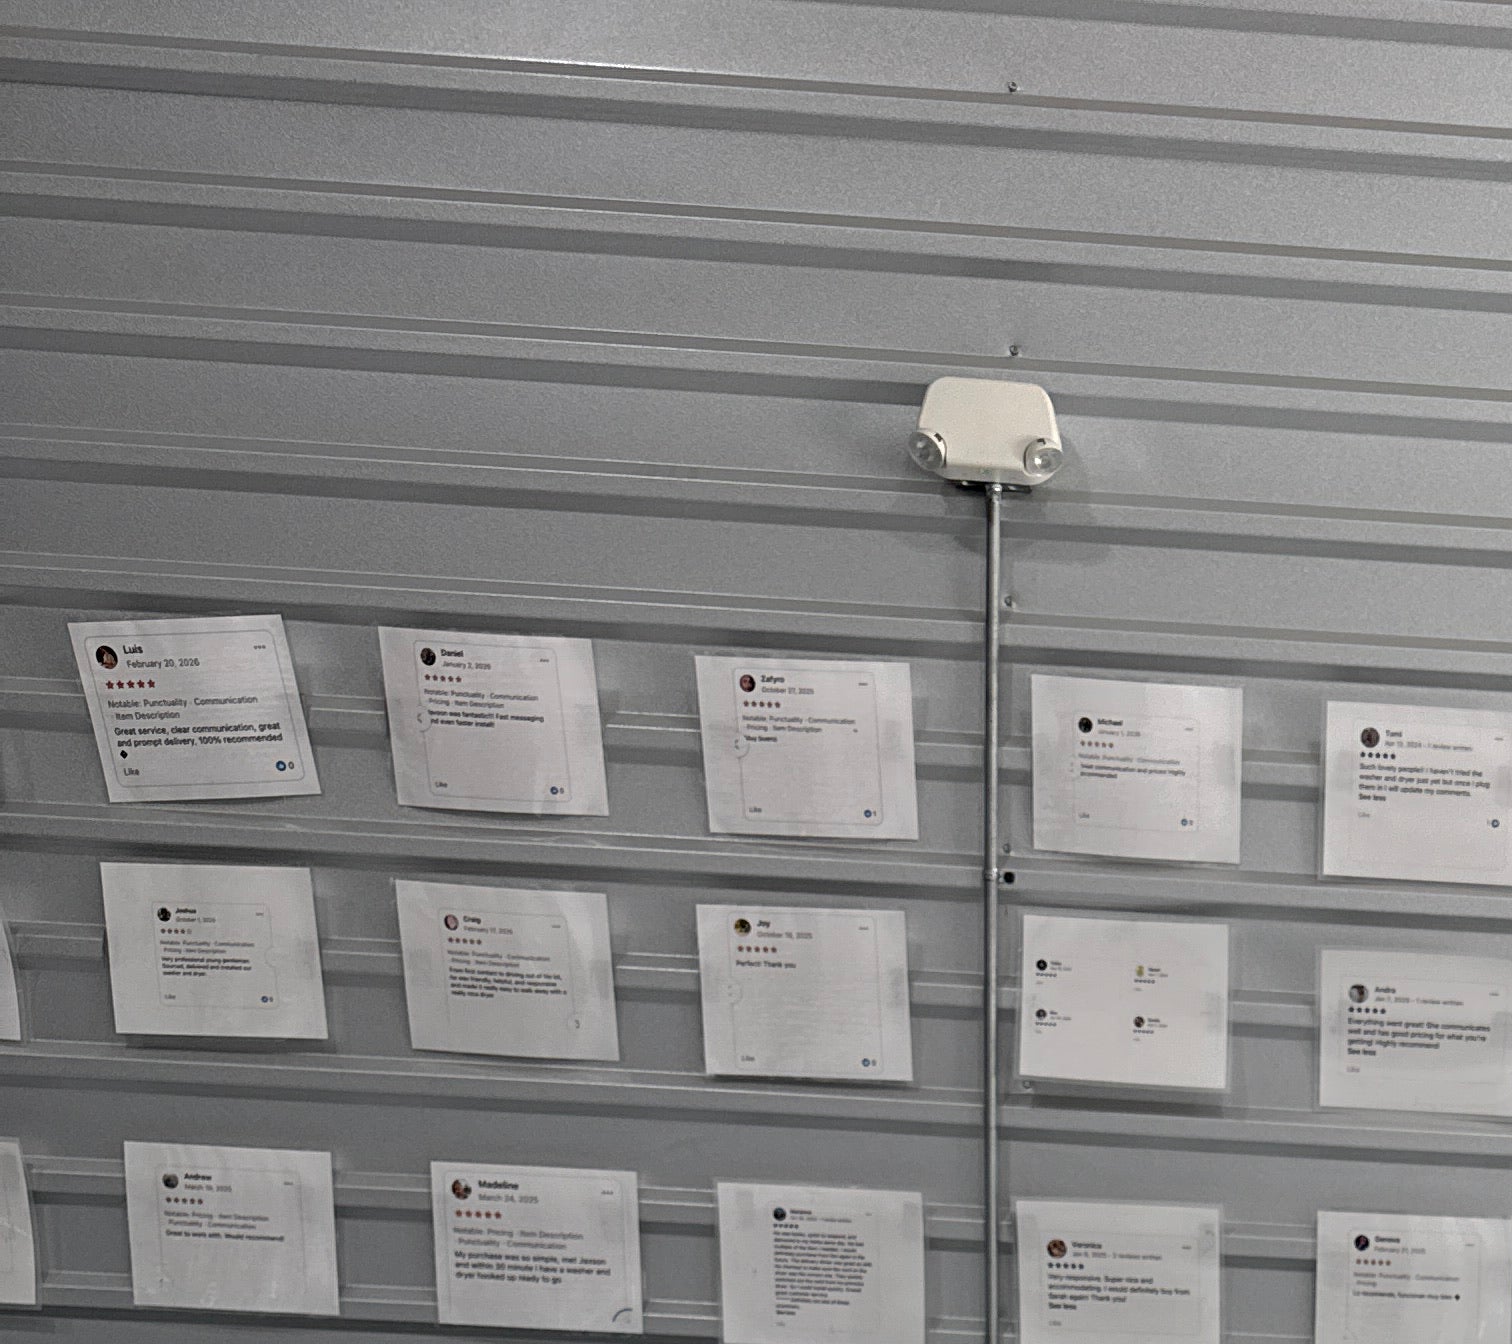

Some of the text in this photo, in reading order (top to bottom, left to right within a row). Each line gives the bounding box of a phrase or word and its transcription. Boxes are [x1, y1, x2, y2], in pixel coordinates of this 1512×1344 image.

[123, 645, 143, 654] Luis
[127, 659, 161, 668] February
[144, 699, 187, 708] Punctuality
[194, 696, 258, 705] Communication
[135, 711, 180, 721] Description
[115, 727, 136, 735] Great
[259, 723, 280, 732] great
[118, 739, 132, 747] and
[134, 738, 162, 748] prompt
[223, 734, 283, 744] recommended
